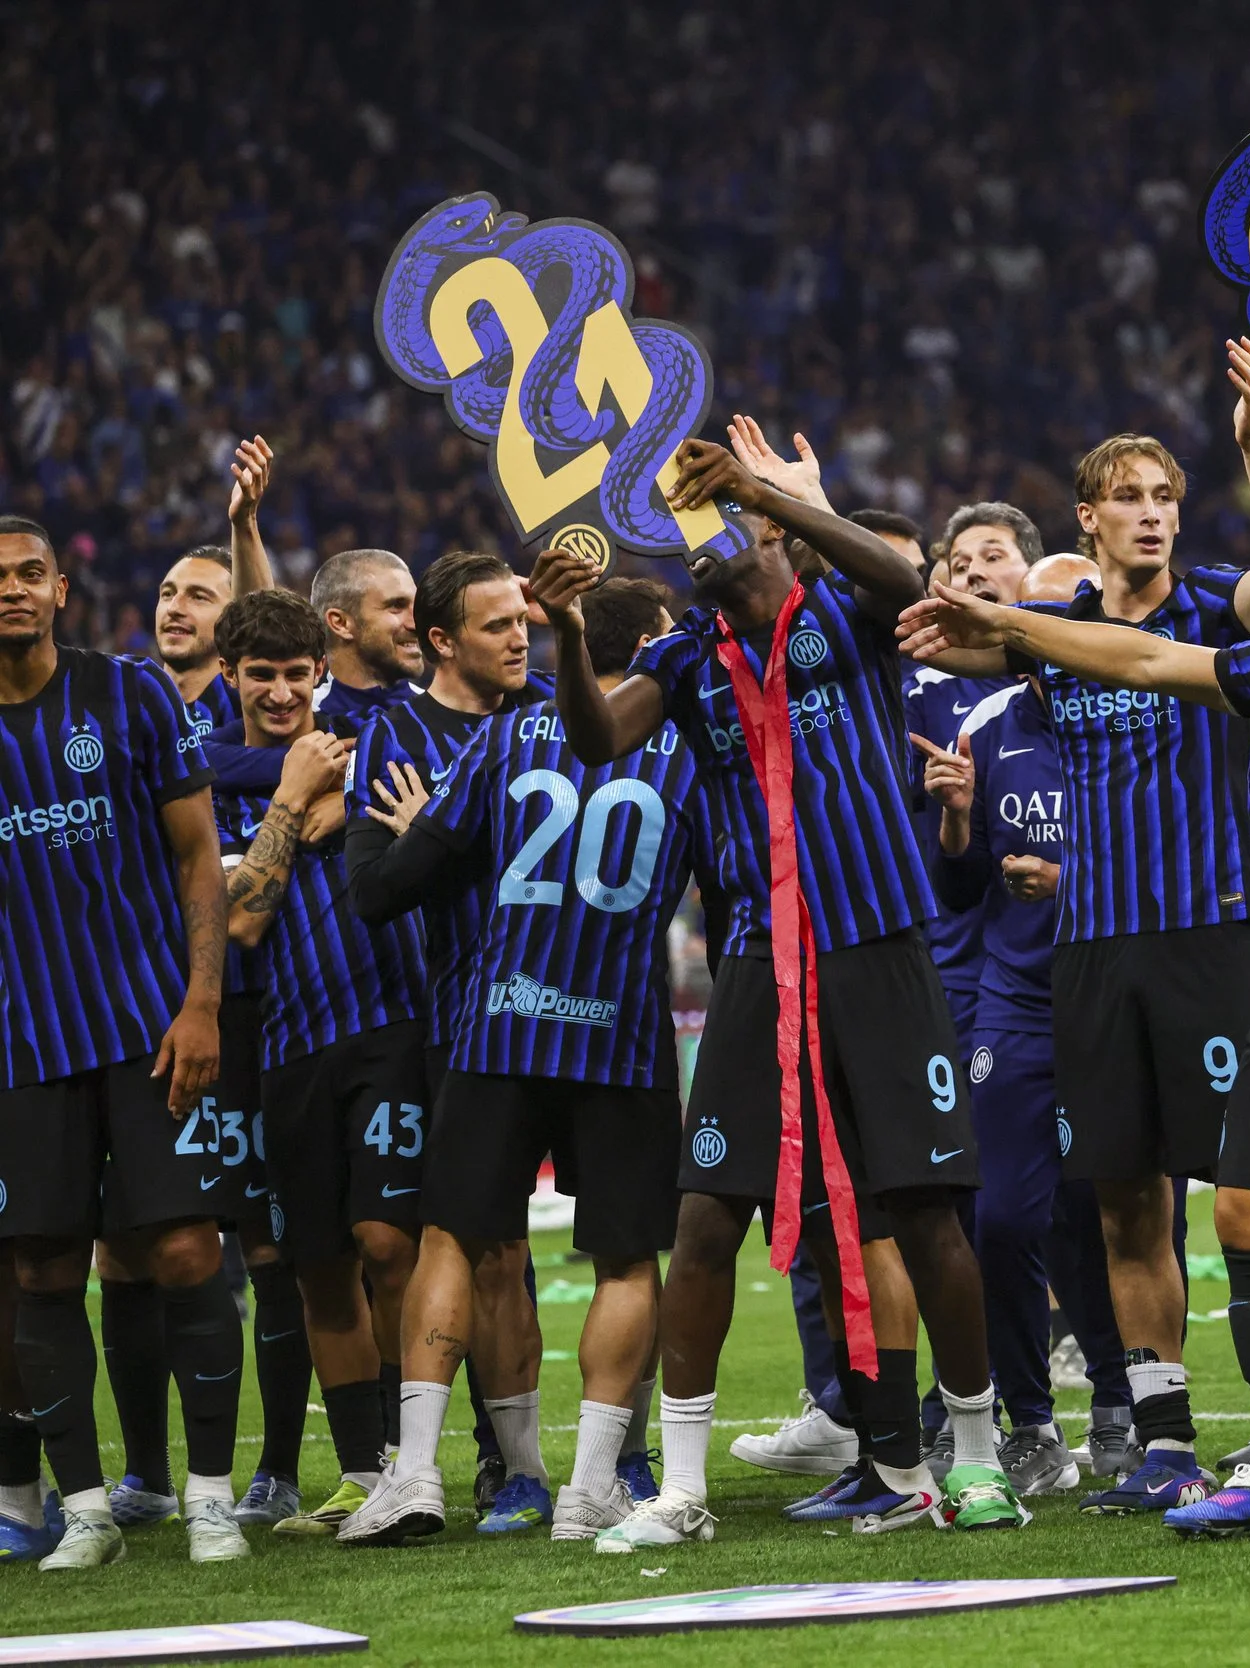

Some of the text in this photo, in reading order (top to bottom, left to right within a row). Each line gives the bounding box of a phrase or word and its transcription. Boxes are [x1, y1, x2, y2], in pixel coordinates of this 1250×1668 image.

[789, 705, 850, 738] sport
[1109, 707, 1177, 733] .sport
[0, 795, 112, 842] etsson
[1000, 791, 1063, 829] QAT
[48, 820, 115, 850] .sport
[498, 769, 666, 913] 20
[927, 1054, 956, 1112] 9
[364, 1102, 424, 1158] 43
